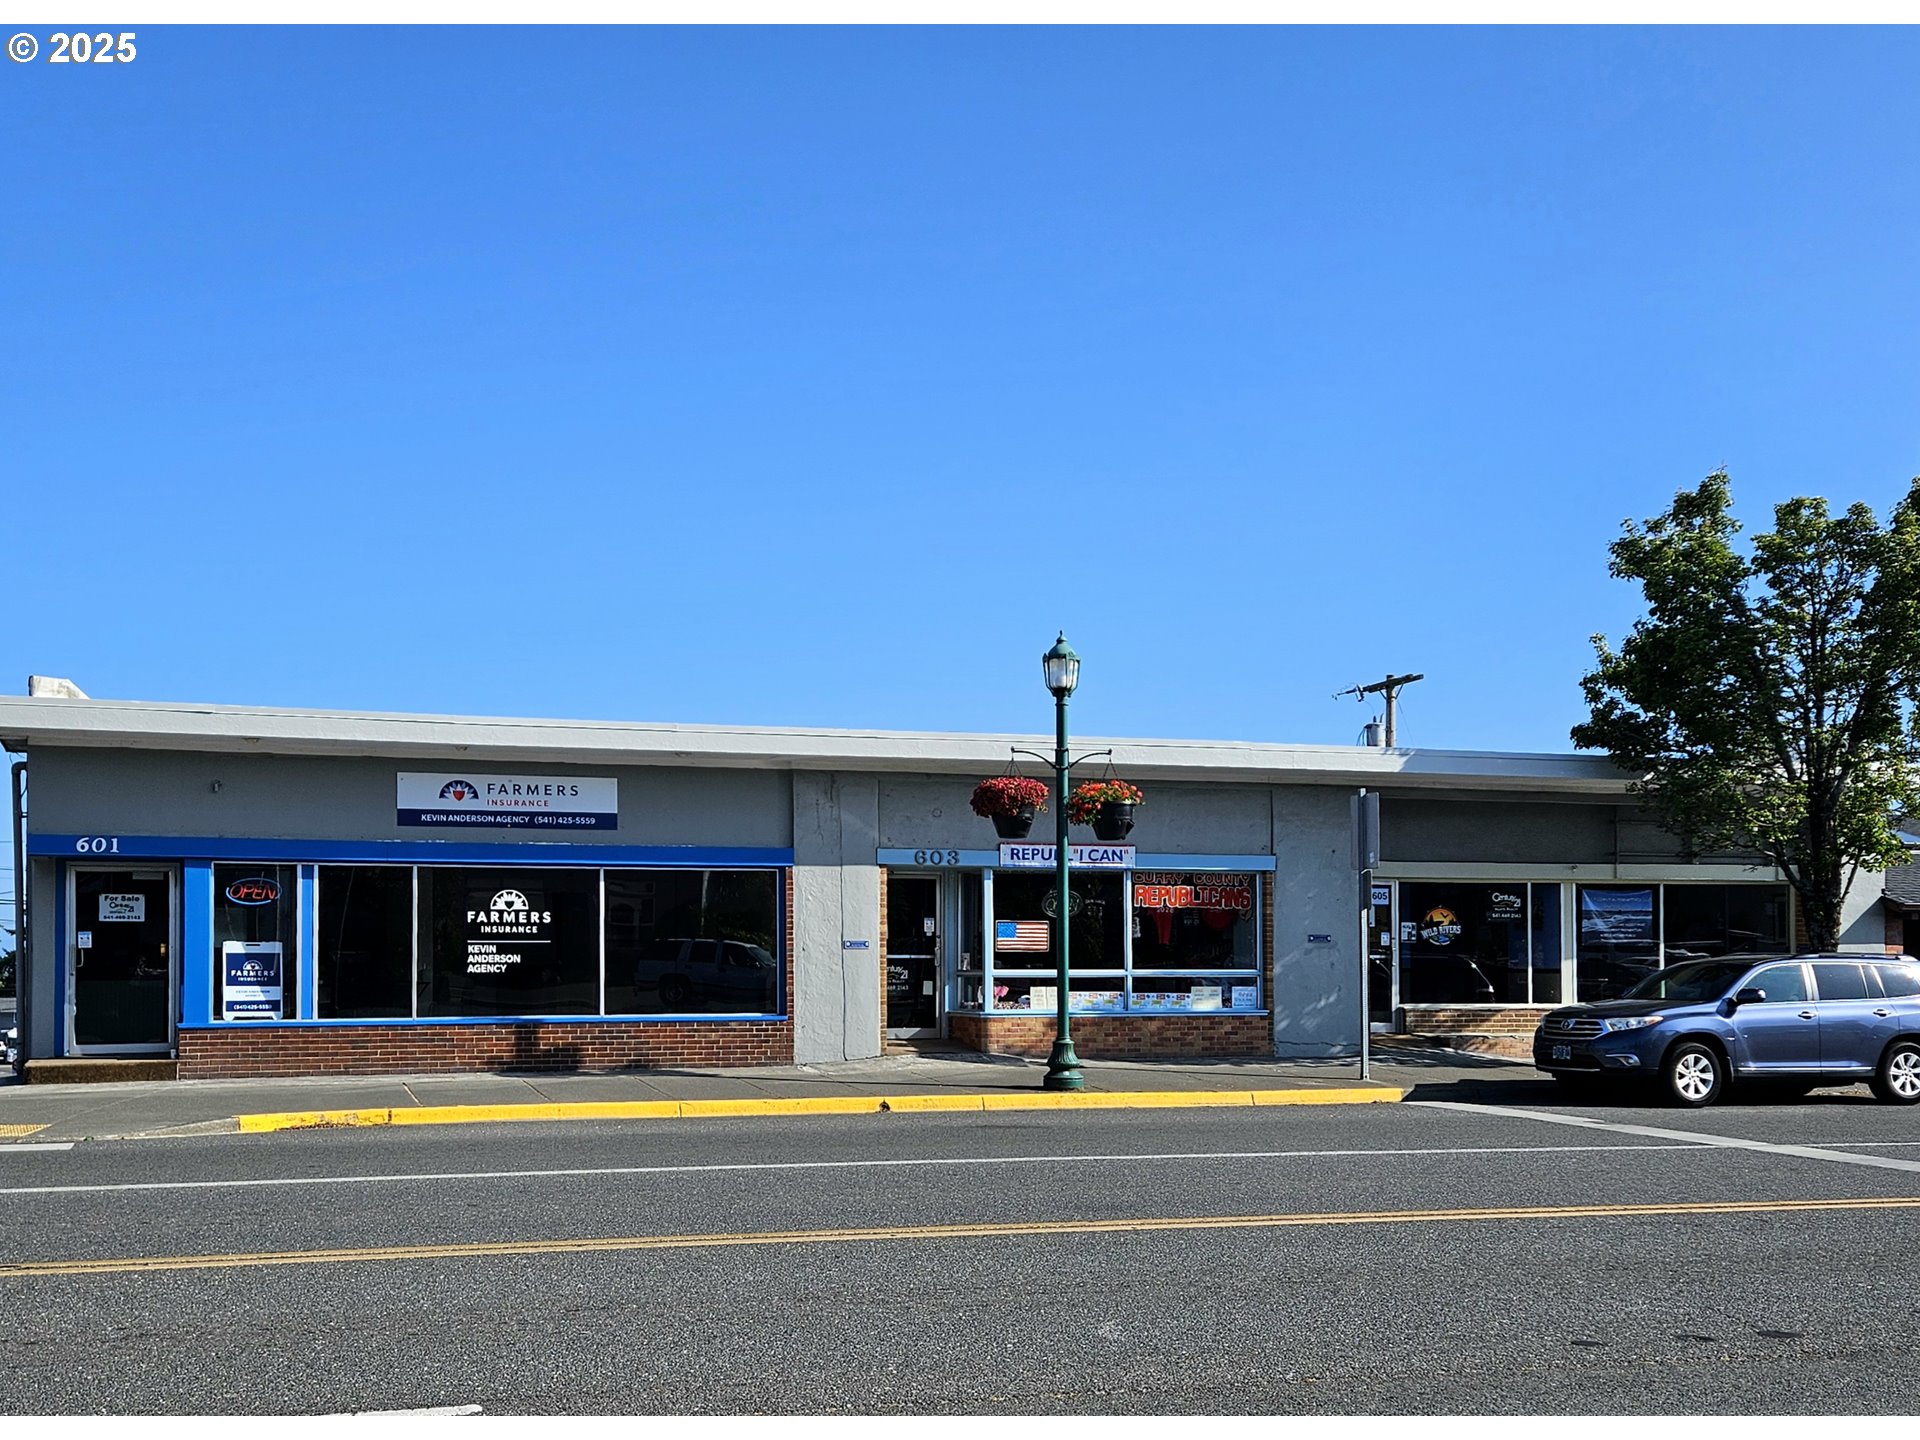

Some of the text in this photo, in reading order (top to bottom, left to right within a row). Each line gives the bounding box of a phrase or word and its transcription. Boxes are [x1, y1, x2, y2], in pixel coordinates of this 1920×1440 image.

[486, 783, 579, 797] FARMERS
[486, 799, 550, 807] INSURANCE
[420, 813, 596, 825] KEVIN ANDERSON AGENCY (541) 425-5559
[76, 837, 120, 854] 601
[914, 850, 960, 866] 603
[1010, 847, 1074, 861] REPU
[1133, 872, 1251, 886] CURRY COUNTY
[230, 884, 277, 899] OPEN
[1133, 885, 1253, 910] REPUBLICANS
[1372, 891, 1388, 900] 605
[467, 911, 552, 923] FARMERS
[480, 925, 538, 933] INSURANCE
[1420, 927, 1438, 939] WILD
[1438, 925, 1462, 935] RIVERS
[467, 945, 497, 954] KEVIN
[467, 954, 521, 963] ANDERSON
[467, 964, 507, 973] AGENCY
